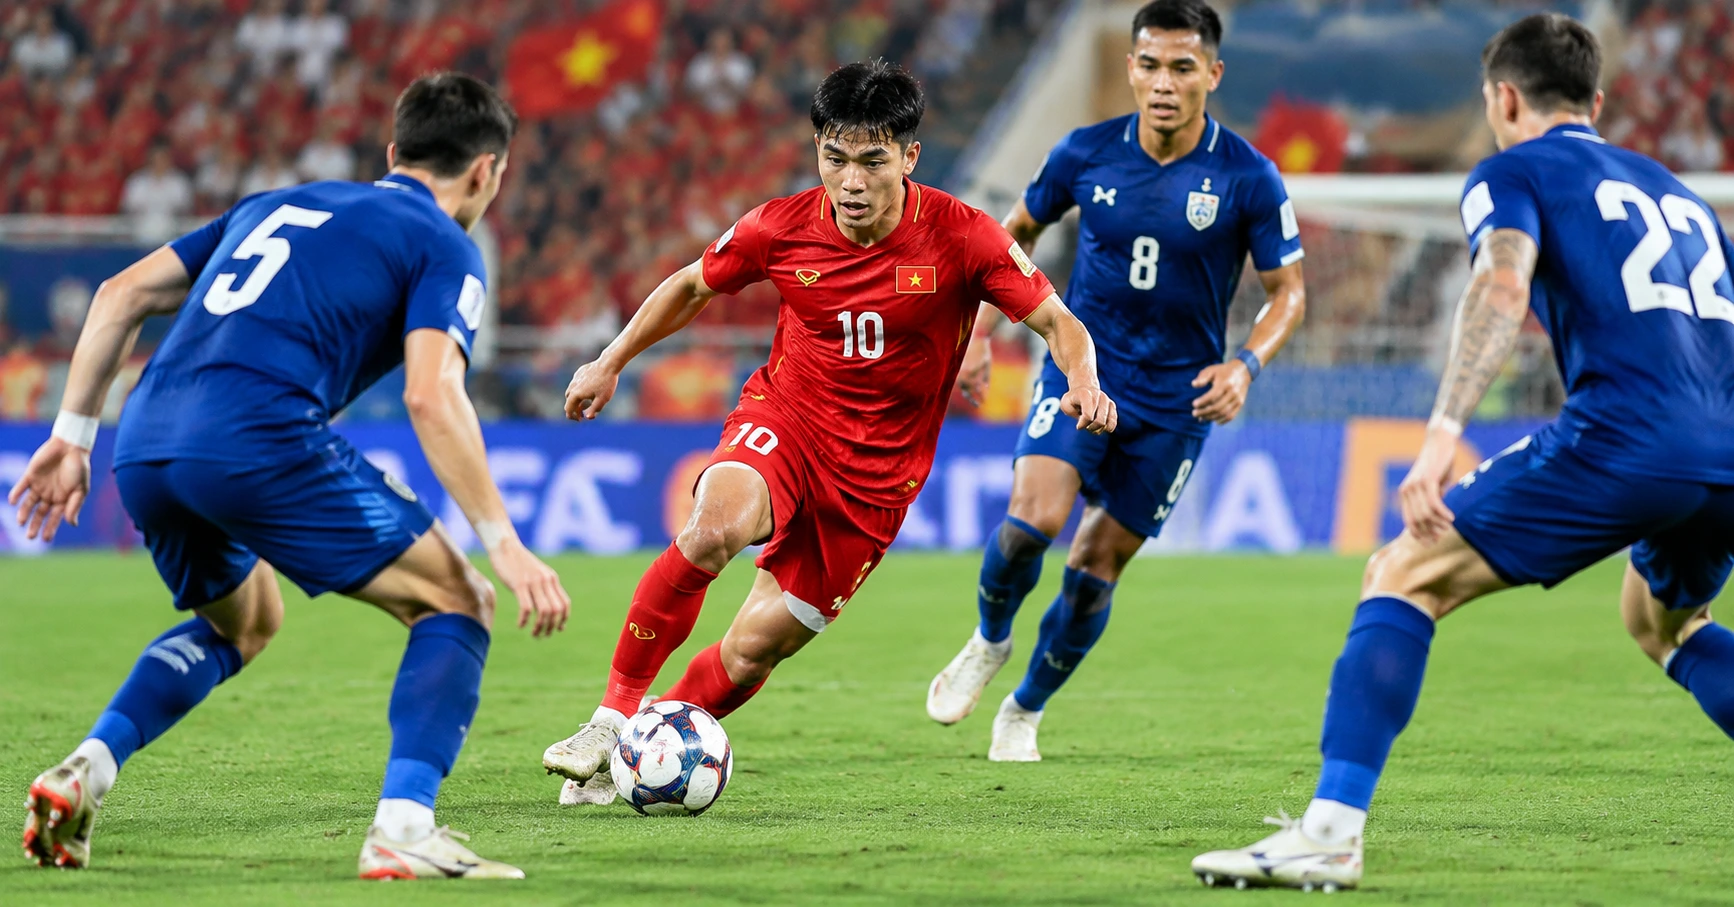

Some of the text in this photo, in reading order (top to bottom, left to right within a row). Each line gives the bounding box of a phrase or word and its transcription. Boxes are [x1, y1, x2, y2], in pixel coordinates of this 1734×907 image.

[203, 203, 334, 316] 5
[1129, 235, 1160, 290] 8
[1594, 179, 1734, 325] 22
[837, 311, 884, 359] 10
[728, 422, 779, 456] 10
[1027, 396, 1061, 440] 8
[1166, 458, 1193, 504] 8
